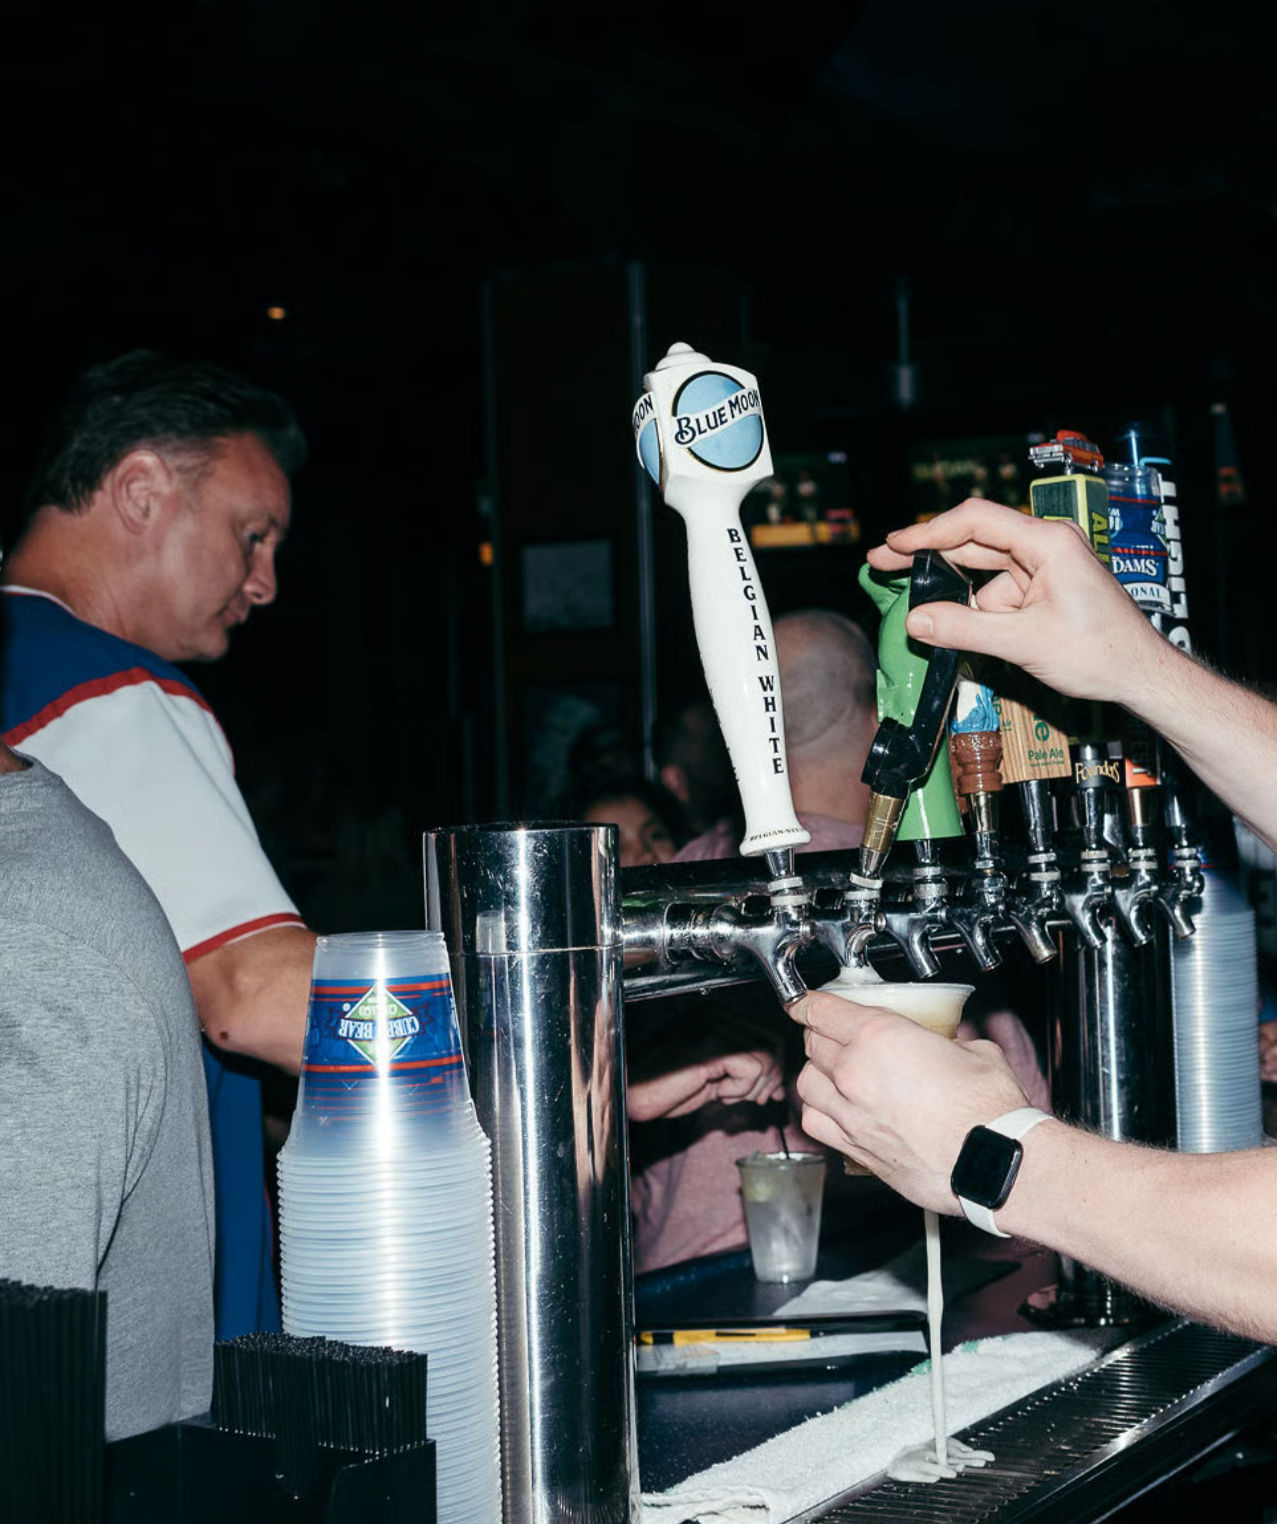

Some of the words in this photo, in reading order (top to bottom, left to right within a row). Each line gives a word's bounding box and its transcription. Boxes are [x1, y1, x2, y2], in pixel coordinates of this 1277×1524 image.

[674, 405, 728, 445] BLUE
[727, 389, 760, 419] MOON
[1157, 473, 1189, 619] LIGHT
[1111, 558, 1158, 577] DAMS
[1130, 586, 1161, 599] ONAL
[726, 527, 769, 661] BELGIAN
[757, 675, 785, 775] WHITE
[1027, 748, 1047, 761] Pale
[1049, 747, 1064, 759] Ale
[337, 1018, 373, 1040] BEAR
[378, 1016, 420, 1040] CUBB
